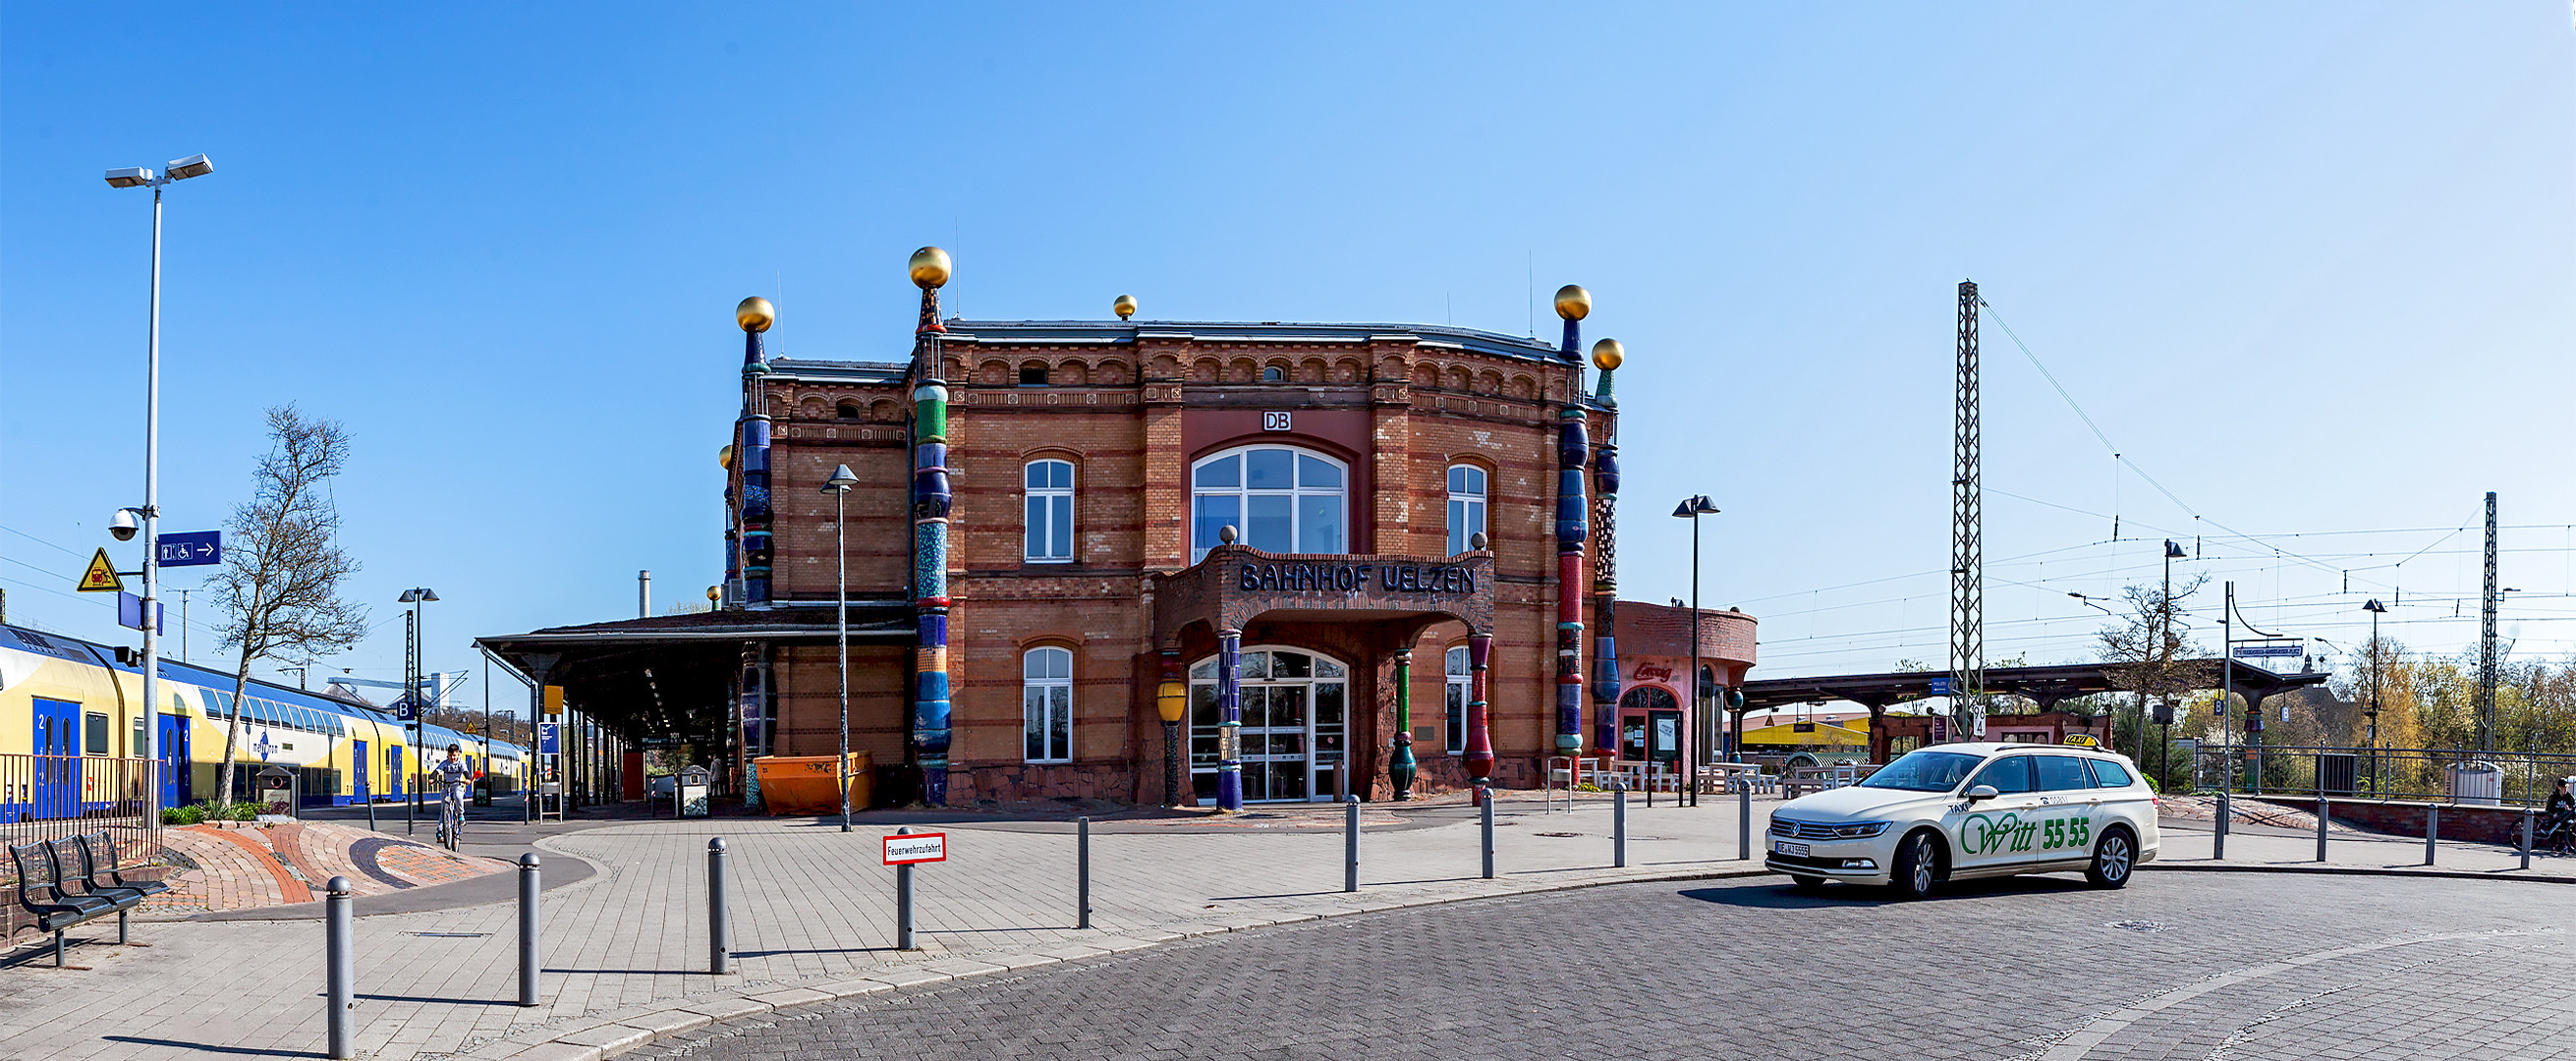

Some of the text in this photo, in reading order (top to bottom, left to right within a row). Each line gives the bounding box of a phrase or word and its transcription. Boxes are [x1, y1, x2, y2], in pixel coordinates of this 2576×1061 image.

[1265, 413, 1290, 429] DB
[1240, 563, 1477, 594] BAHNHOF UELZEN
[399, 701, 409, 717] B
[1974, 705, 1986, 720] 96
[2215, 699, 2222, 713] B
[2283, 707, 2289, 719] B
[38, 713, 44, 730] 2
[1977, 720, 1983, 734] 4
[184, 729, 189, 742] 2
[2066, 735, 2086, 744] TAXI
[1948, 803, 1970, 814] TAXI
[1961, 812, 2090, 856] Witt 55 55
[887, 844, 941, 857] Feuerwehrzufahrt
